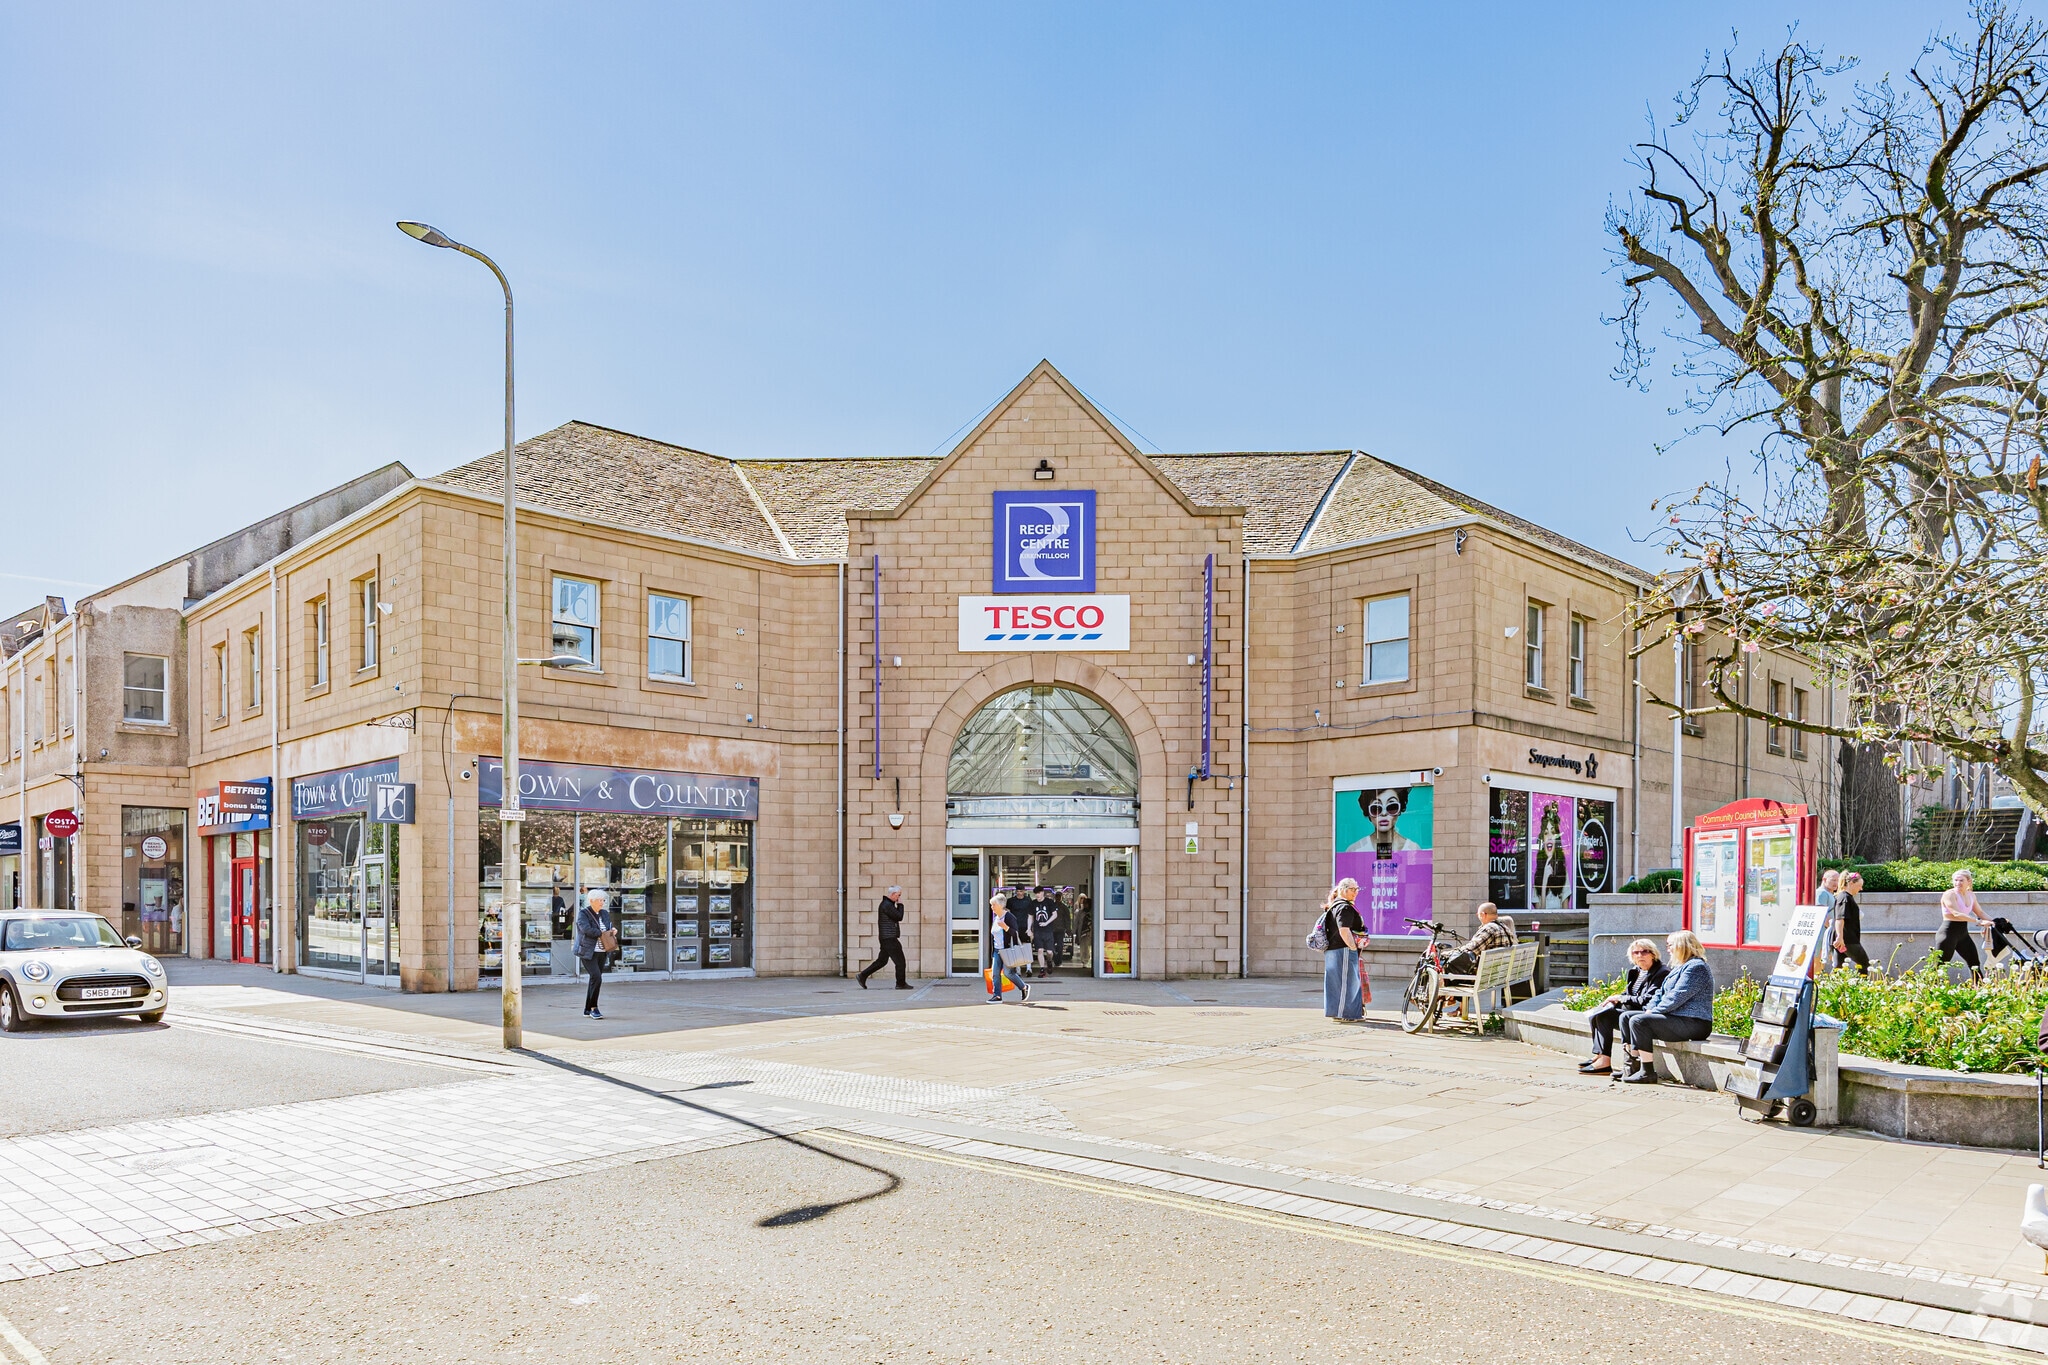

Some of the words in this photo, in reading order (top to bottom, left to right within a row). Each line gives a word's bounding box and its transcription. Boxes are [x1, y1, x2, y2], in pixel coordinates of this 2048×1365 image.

[1019, 524, 1070, 535] REGENT
[1020, 539, 1070, 549] CENTRE
[984, 605, 1105, 629] TESCO
[1529, 748, 1583, 775] Superdrug
[223, 785, 267, 796] BETFRED
[598, 780, 613, 800] &
[629, 775, 749, 810] COUNTRY
[294, 782, 326, 815] TOWN
[330, 784, 338, 802] &
[250, 803, 267, 811] king
[1703, 813, 1733, 824] Community
[1735, 810, 1757, 821] Council
[1758, 807, 1778, 818] Notice
[1779, 806, 1798, 816] Board
[1490, 838, 1517, 854] save
[1489, 856, 1517, 873] more
[1371, 887, 1398, 896] BROWS
[1371, 900, 1398, 910] LASH
[1801, 912, 1816, 920] FREE
[1797, 920, 1815, 928] BIBLE
[1791, 928, 1815, 937] COURSE
[86, 989, 109, 997] SM68
[111, 988, 128, 996] ZHW
